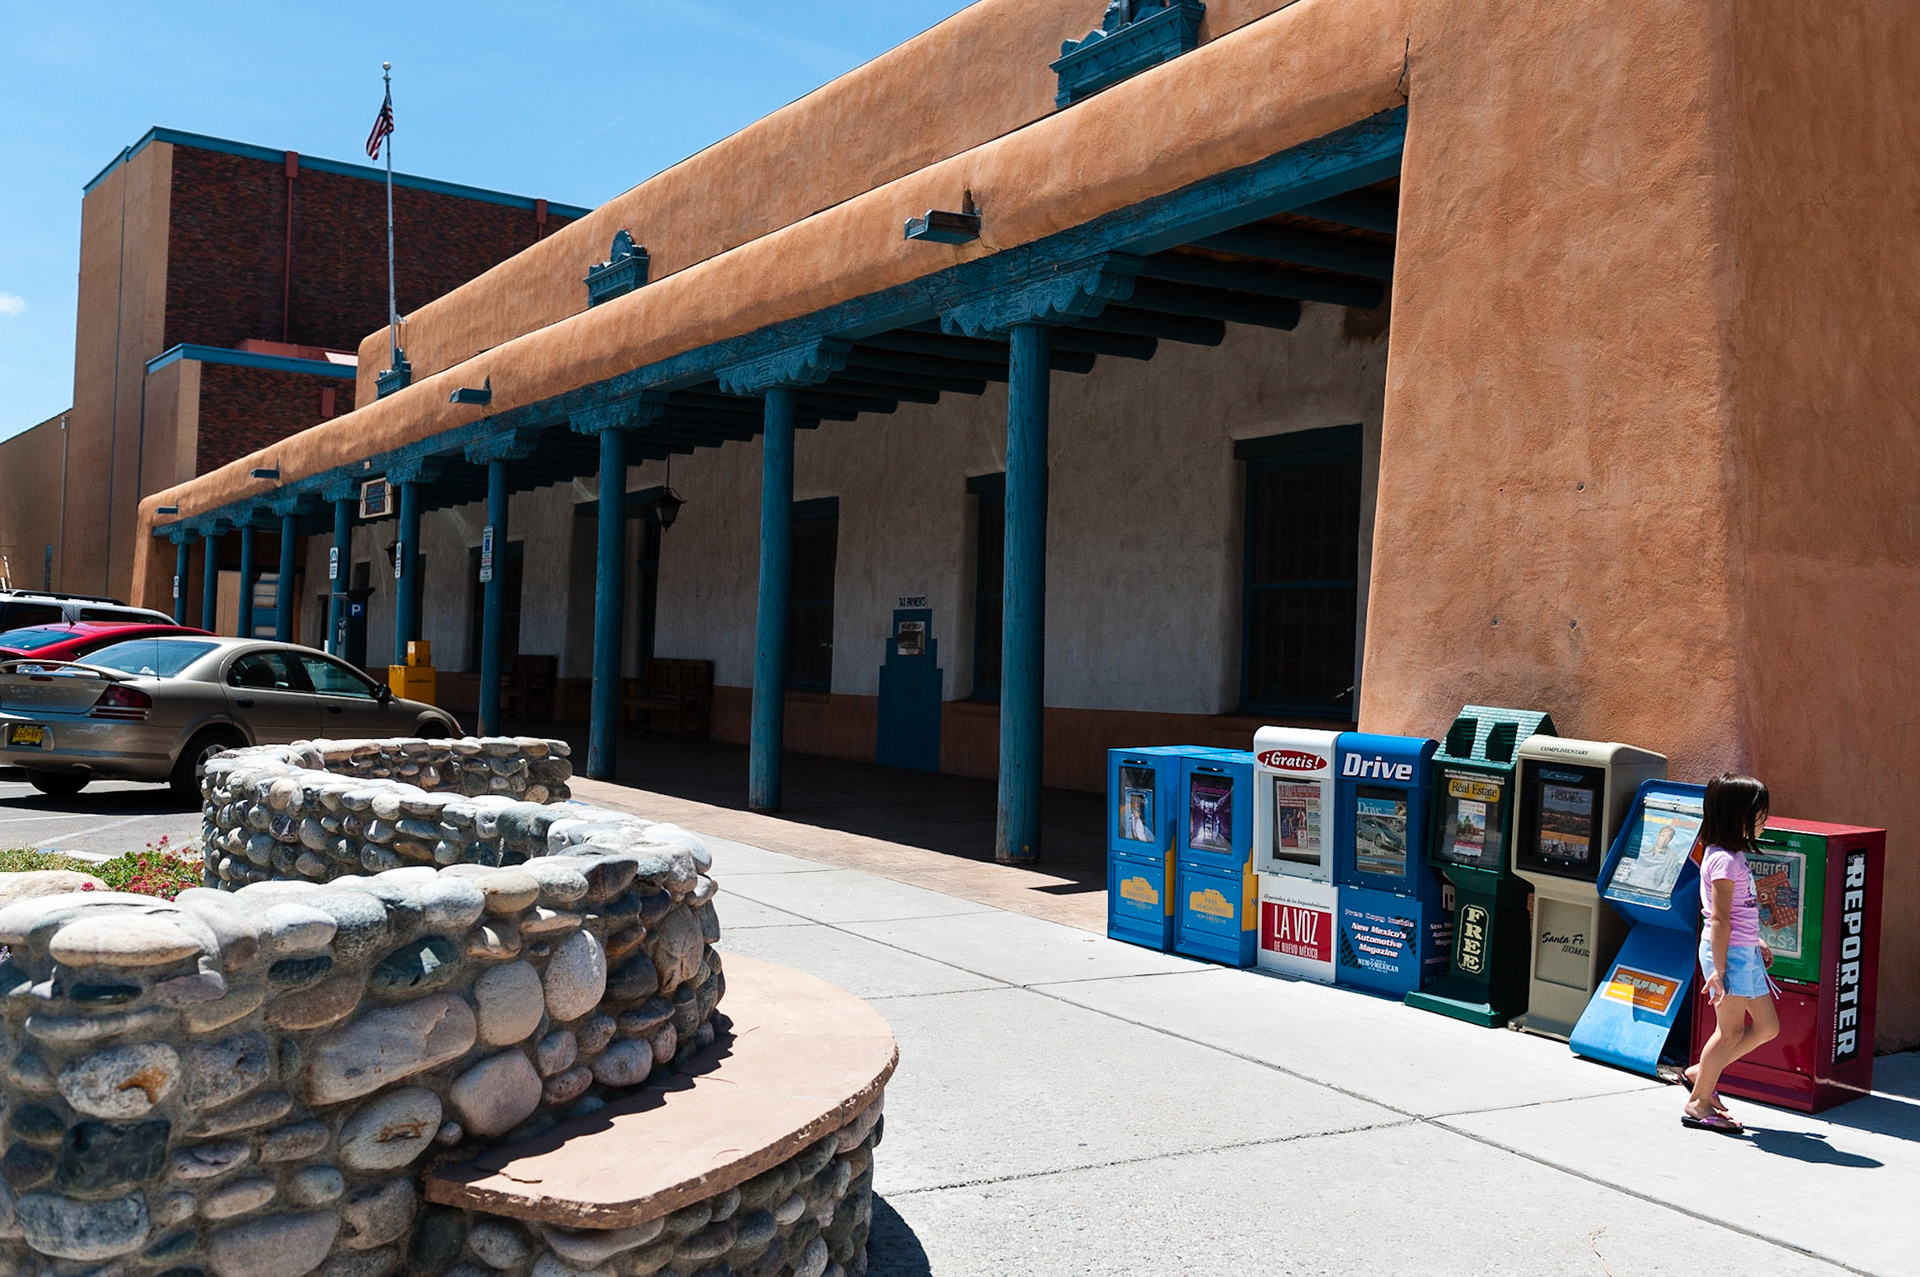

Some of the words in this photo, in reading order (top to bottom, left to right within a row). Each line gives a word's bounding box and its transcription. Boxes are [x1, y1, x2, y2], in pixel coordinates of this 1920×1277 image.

[351, 604, 361, 617] P
[1262, 751, 1320, 770] ¡Gratis!
[1342, 752, 1413, 780] Drive
[1452, 781, 1469, 793] Real
[1472, 784, 1497, 797] Estate
[1551, 792, 1584, 804] HOMES
[1357, 801, 1382, 815] Drive
[1749, 861, 1789, 877] PORTER
[1274, 905, 1290, 940] LA
[1293, 908, 1318, 946] VOZ
[1351, 922, 1369, 933] New
[1370, 927, 1407, 939] Mexico's
[1355, 932, 1403, 949] Automotive
[1461, 907, 1484, 970] FREE
[1541, 931, 1569, 944] Santa
[1572, 933, 1585, 945] Fe
[1274, 940, 1280, 952] DE
[1281, 942, 1298, 955] NUEVO
[1358, 943, 1398, 958] Magazine
[1836, 857, 1865, 1057] REPORTER
[1357, 958, 1370, 967] NEW
[1374, 962, 1399, 973] MEXICAN
[1615, 973, 1667, 995] SUN
